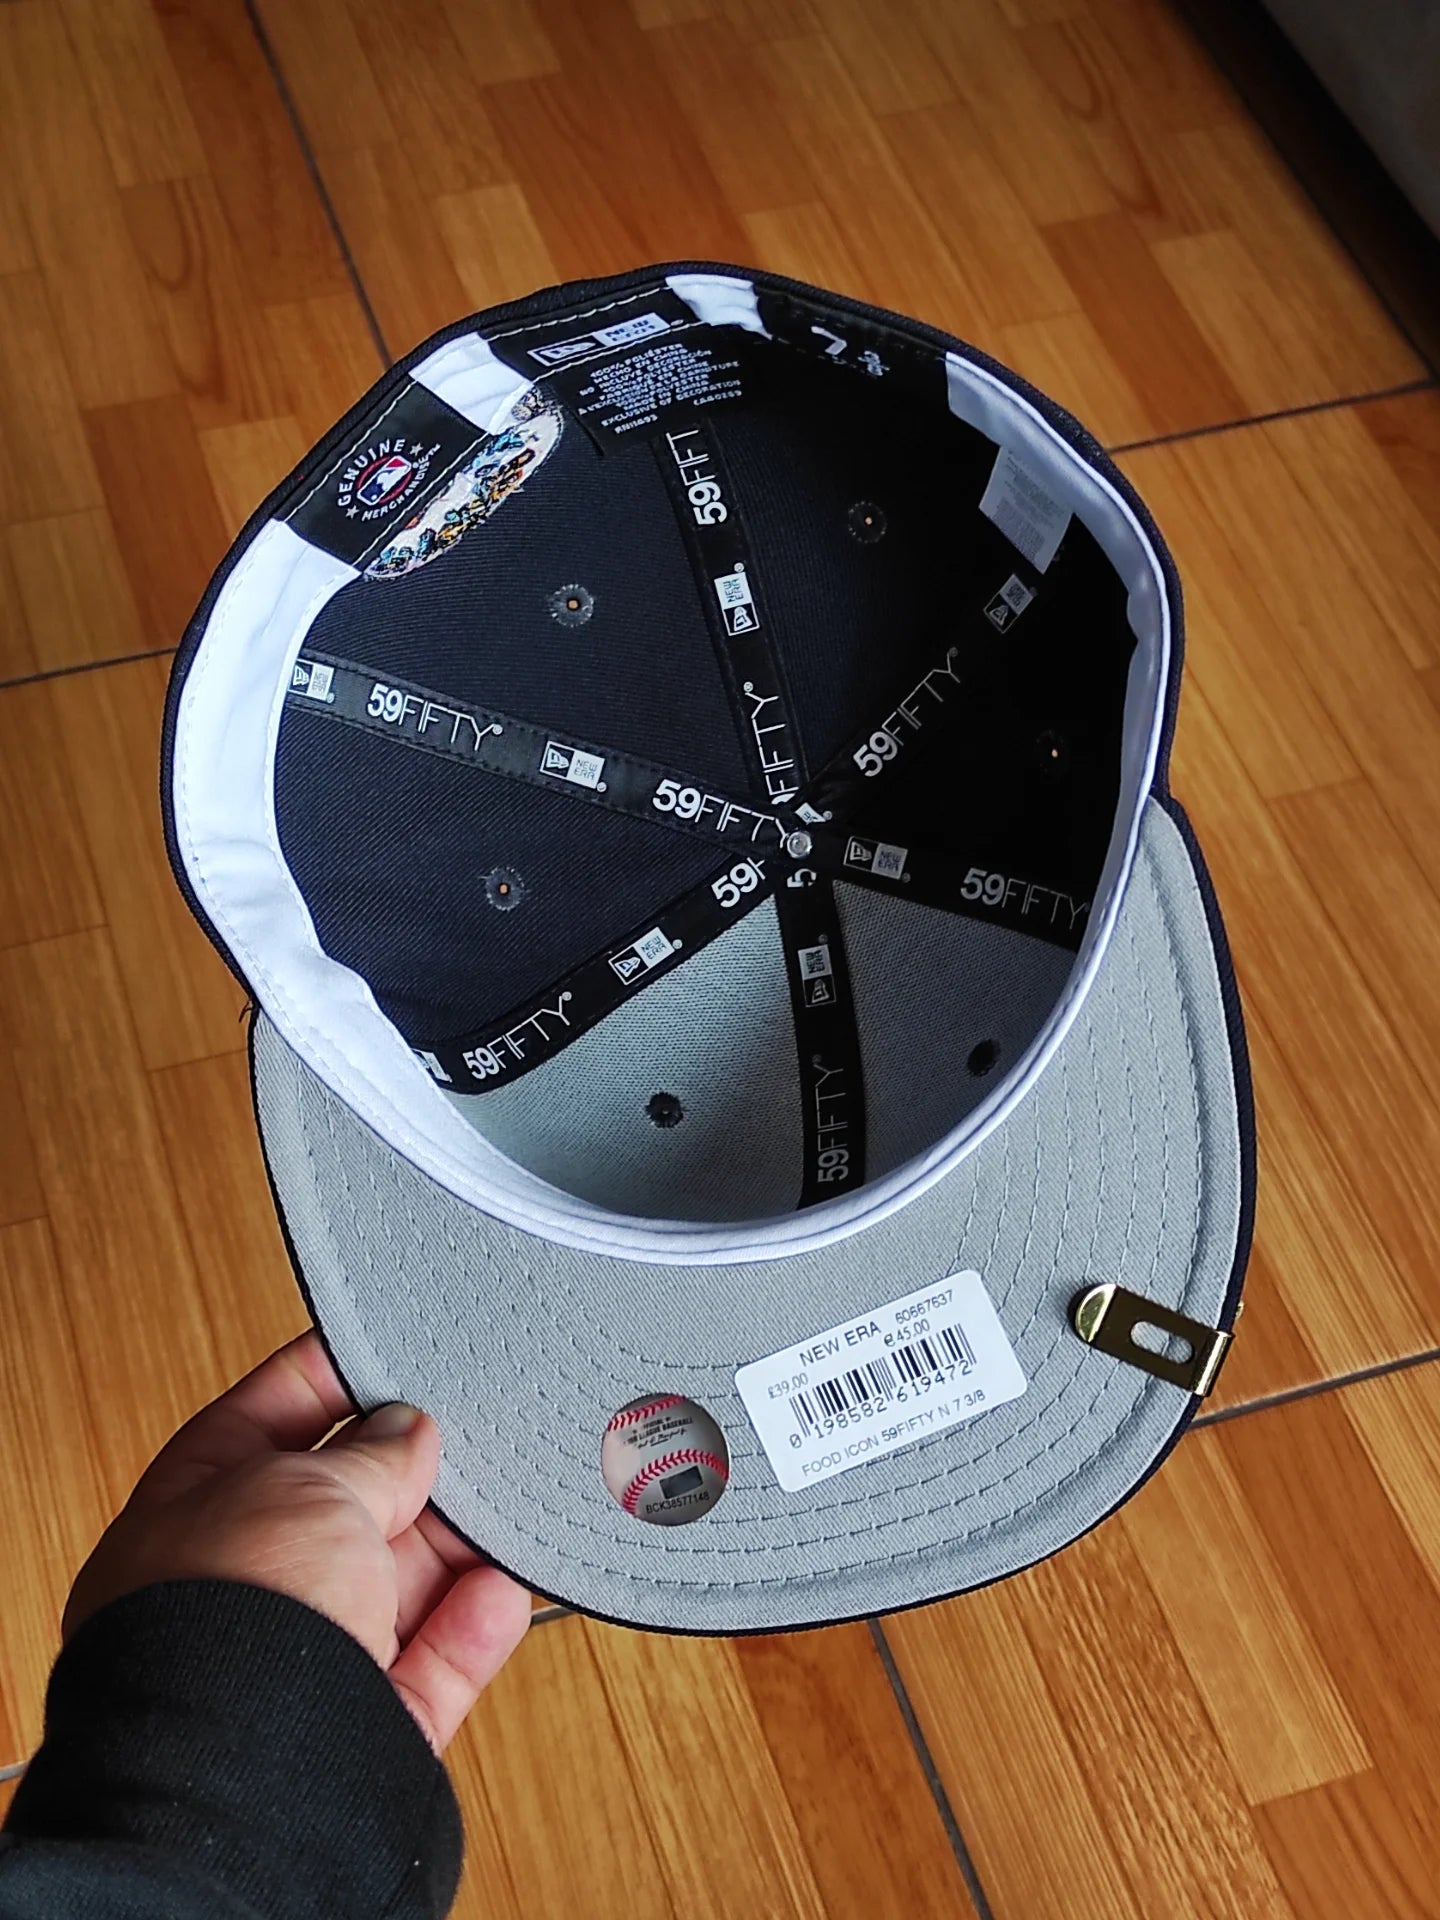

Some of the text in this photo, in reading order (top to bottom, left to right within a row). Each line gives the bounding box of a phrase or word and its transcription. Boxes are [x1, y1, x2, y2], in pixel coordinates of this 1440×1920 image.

[337, 438, 405, 506] GENUINE
[665, 429, 728, 525] 59FIFT
[367, 682, 495, 752] 59FIFTY
[853, 652, 961, 777] 59FIFTY
[960, 867, 1088, 931] 59FIFTY
[462, 995, 570, 1080] 59FIFTY
[814, 1063, 849, 1183] 59FIFTY
[799, 1337, 840, 1367] NEW
[844, 1321, 882, 1347] ERA
[767, 1372, 808, 1400] £39.00
[801, 1389, 986, 1477] FOOD ICON 59FIFTY N 7 3/8
